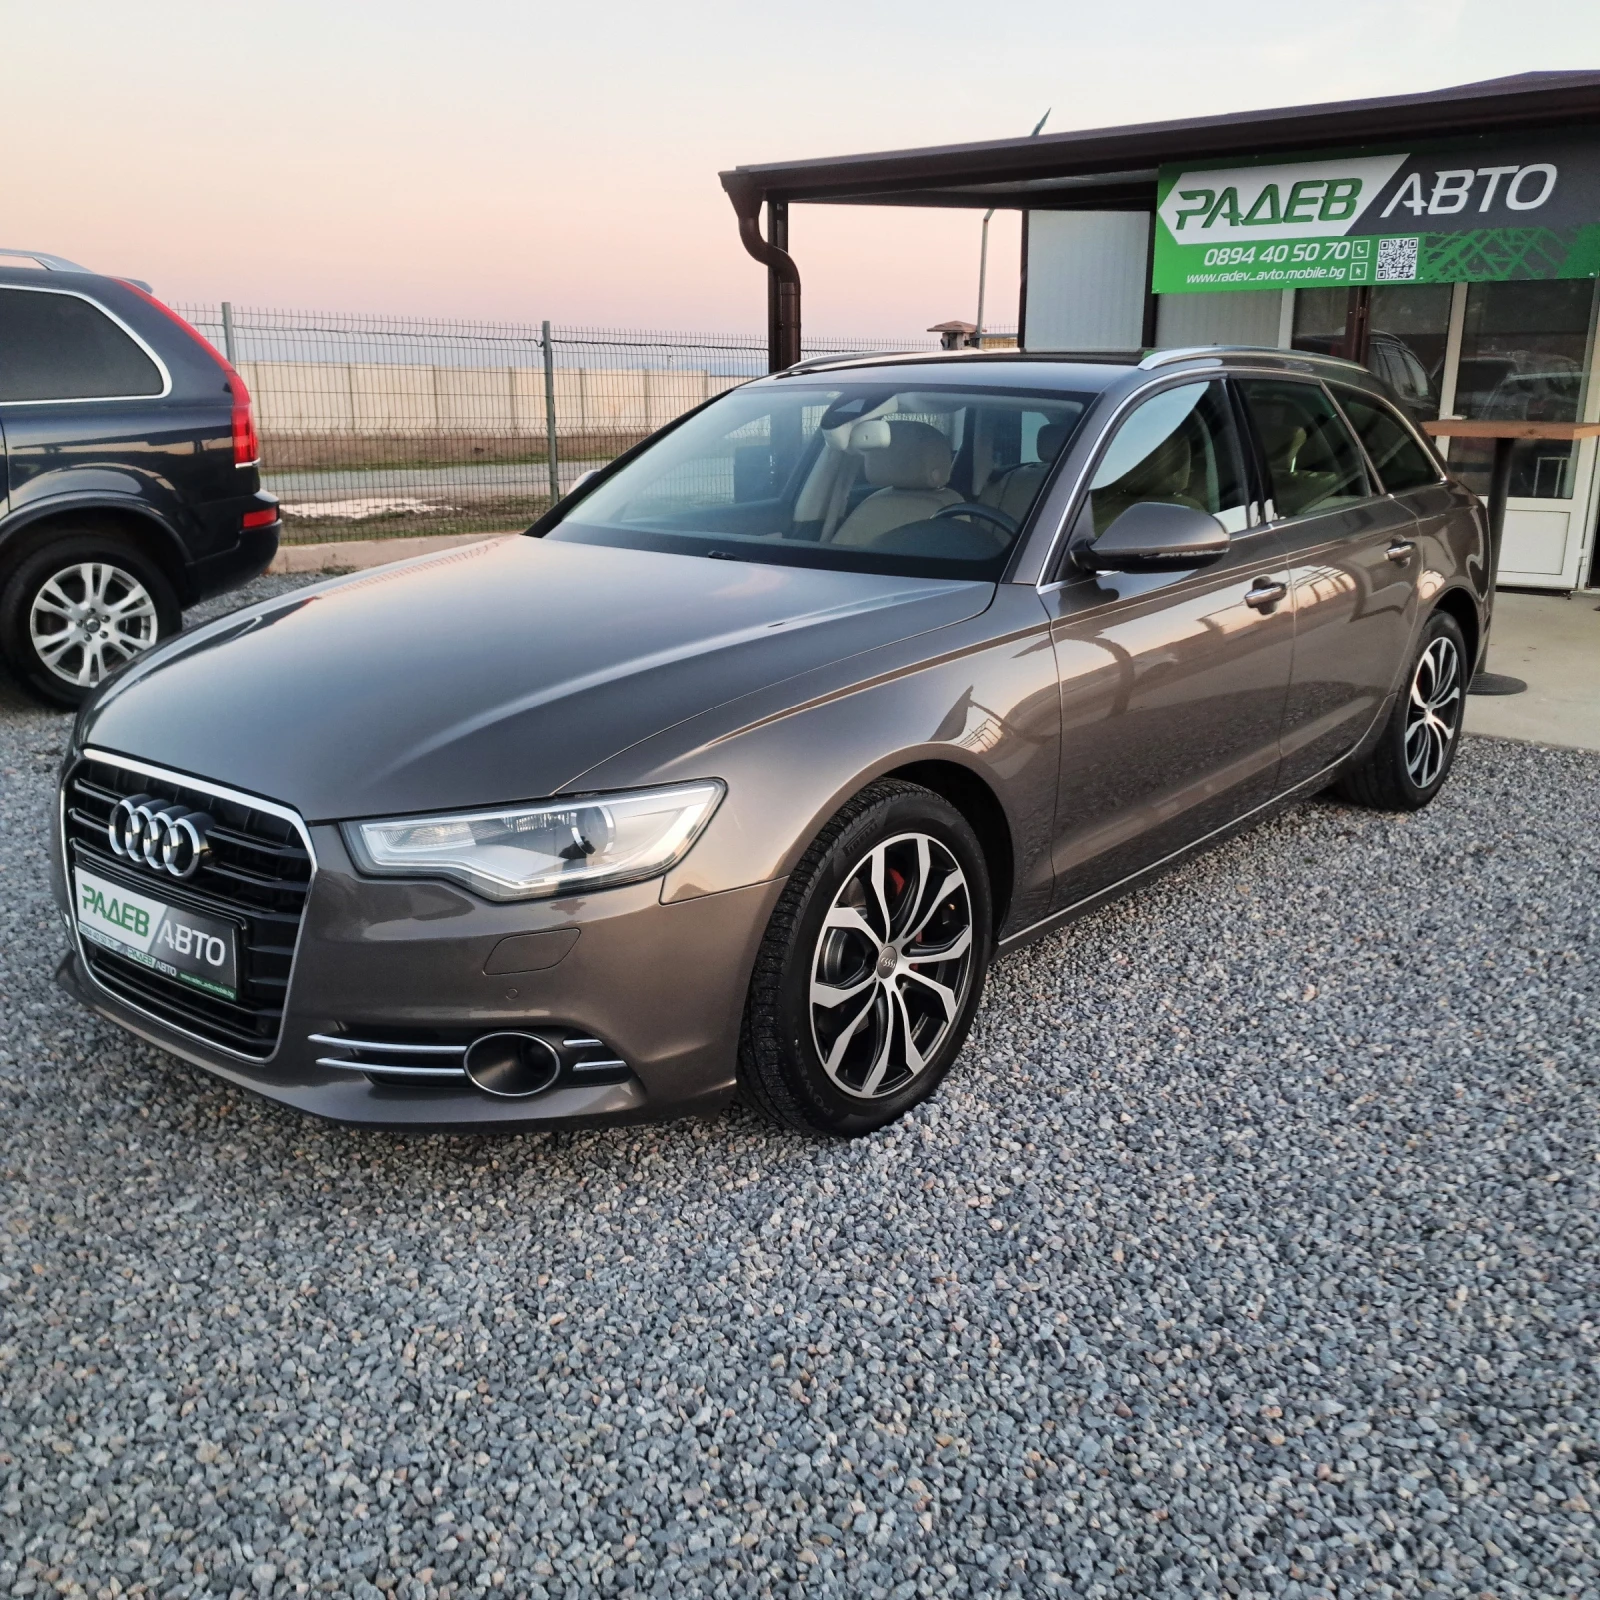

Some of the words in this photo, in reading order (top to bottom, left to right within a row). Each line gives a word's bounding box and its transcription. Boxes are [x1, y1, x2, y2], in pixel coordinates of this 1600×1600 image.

[1176, 178, 1364, 230] РАДЕВ
[1380, 163, 1557, 218] АВТО
[1186, 264, 1346, 284] www.radev_avto.mobile.bg
[1204, 245, 1255, 266] 0894
[1259, 244, 1287, 263] 40
[1291, 242, 1320, 261] 50
[1322, 241, 1351, 260] 70
[81, 883, 150, 938] РАДЕВ
[156, 919, 226, 967] АВТО
